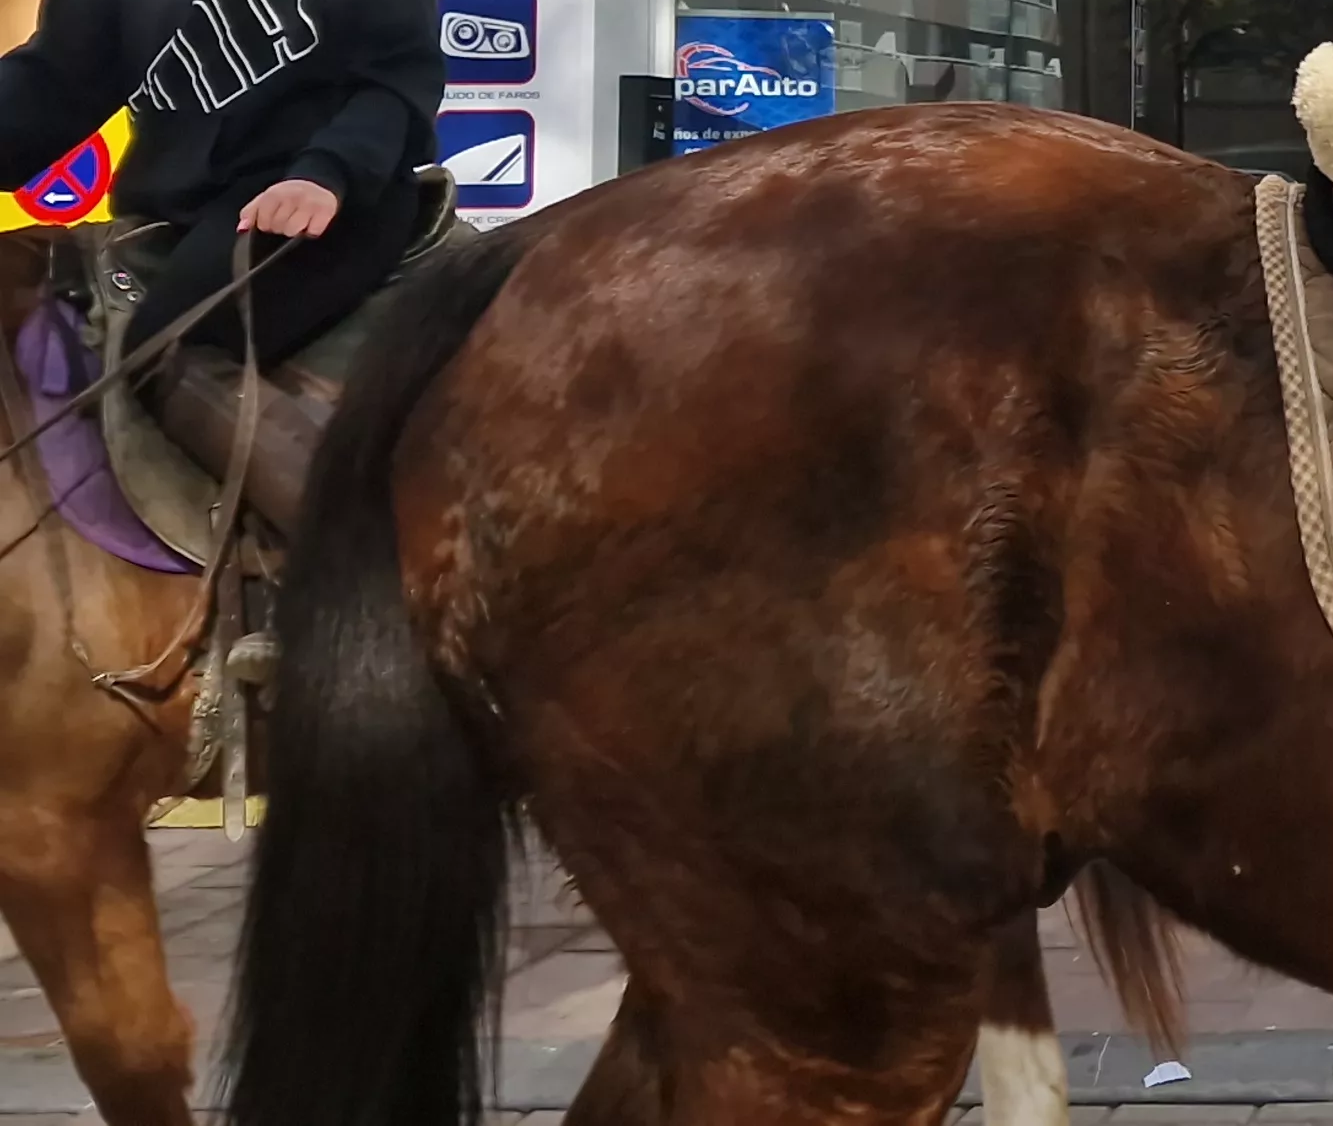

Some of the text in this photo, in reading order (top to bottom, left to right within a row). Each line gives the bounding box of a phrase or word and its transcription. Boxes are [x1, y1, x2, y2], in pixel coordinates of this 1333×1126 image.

[674, 73, 818, 102] parAuto
[478, 90, 495, 100] DE
[498, 90, 541, 100] FAROS
[673, 127, 699, 141] ños
[702, 127, 721, 141] de
